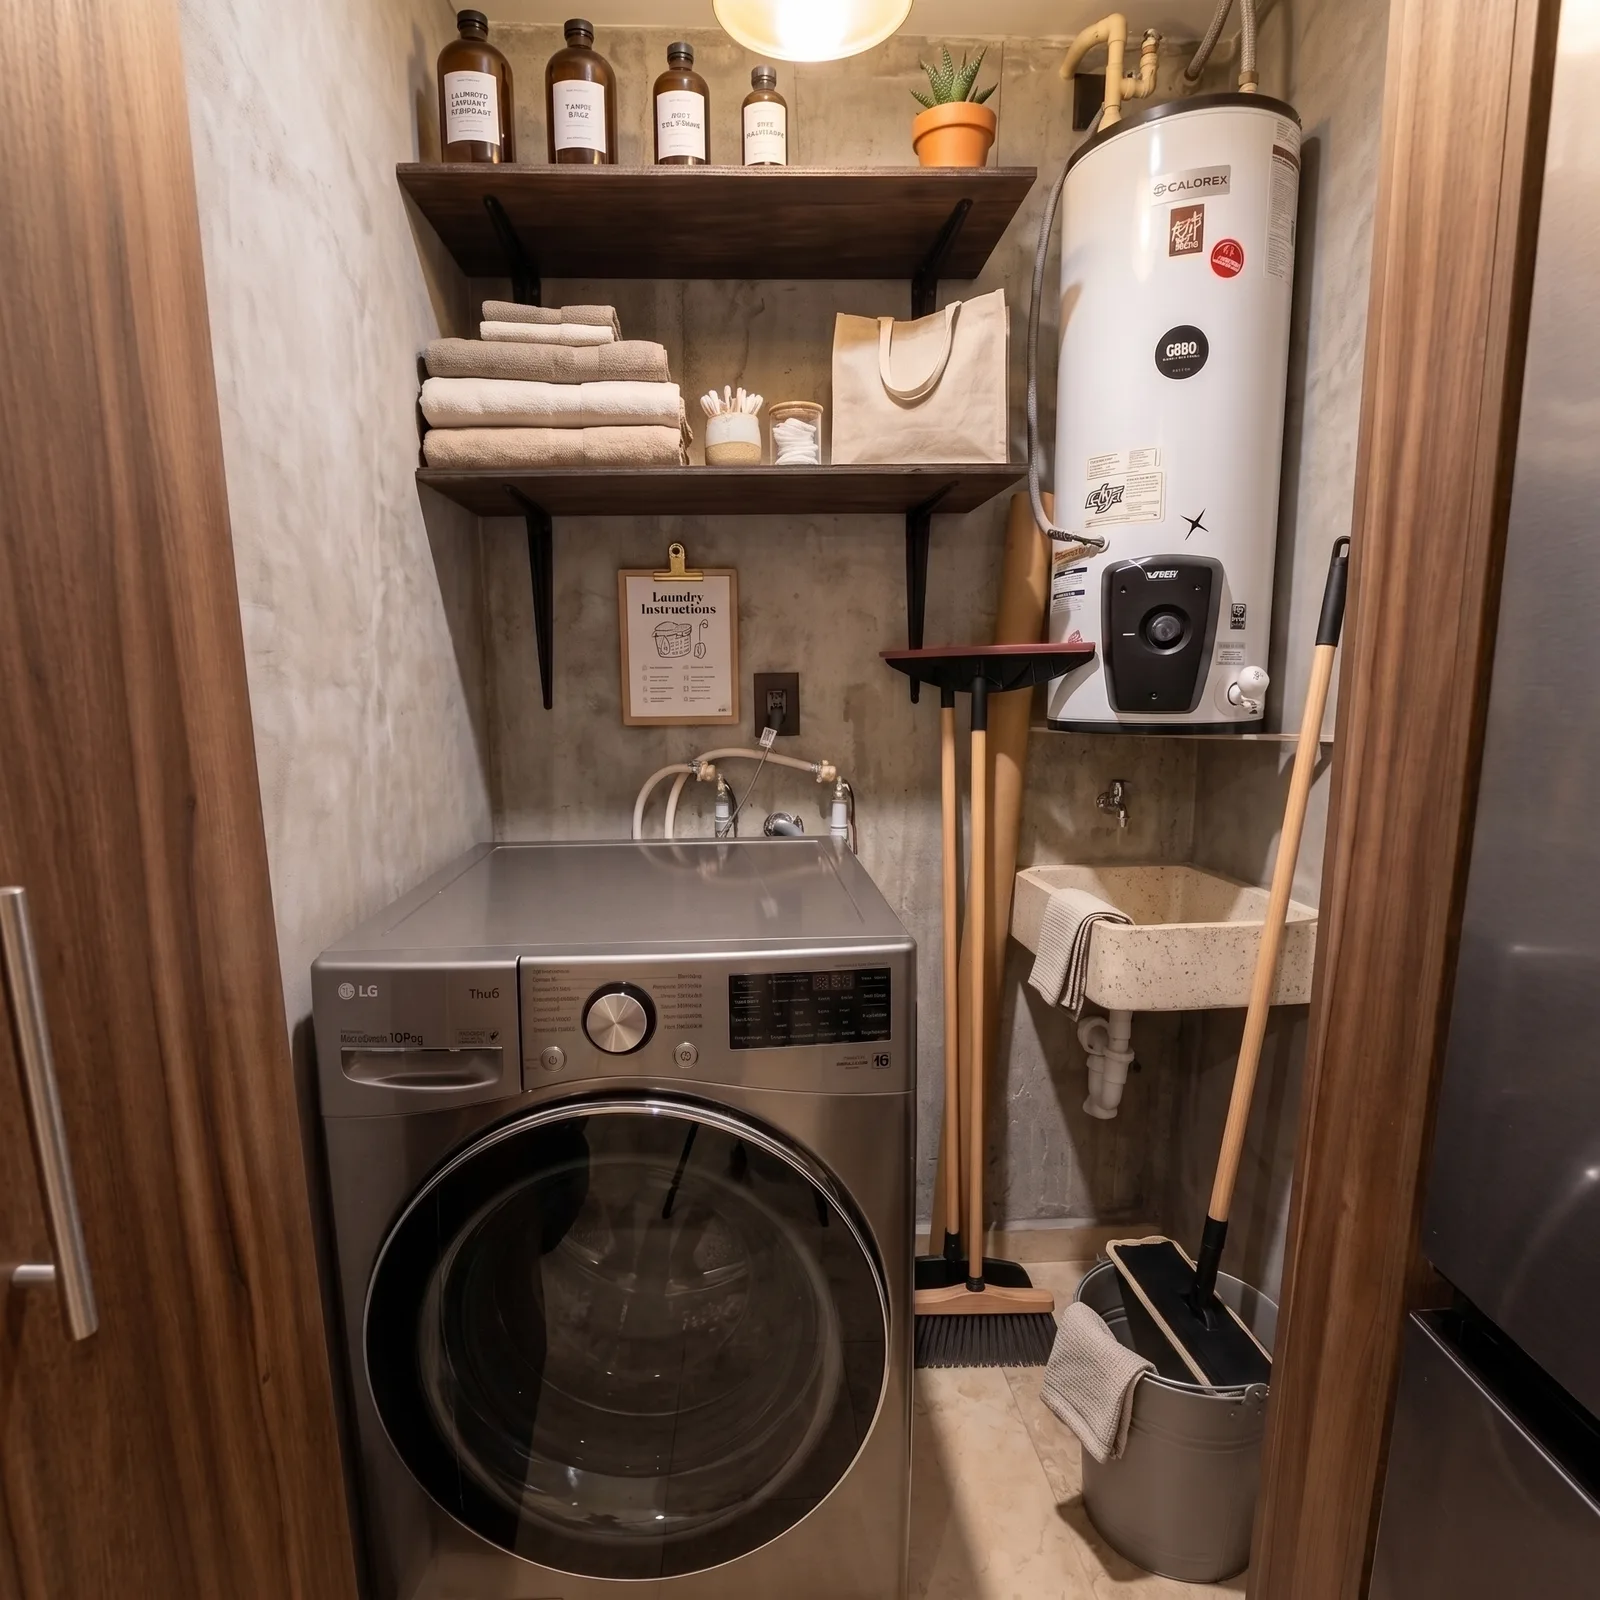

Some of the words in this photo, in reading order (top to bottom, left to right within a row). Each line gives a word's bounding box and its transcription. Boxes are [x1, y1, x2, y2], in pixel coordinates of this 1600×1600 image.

[1167, 175, 1228, 192] CALOREX
[652, 591, 705, 605] Laundry
[641, 602, 717, 615] Instructions
[358, 985, 378, 998] LG
[469, 987, 500, 1000] Thu6
[874, 1054, 889, 1067] 16
